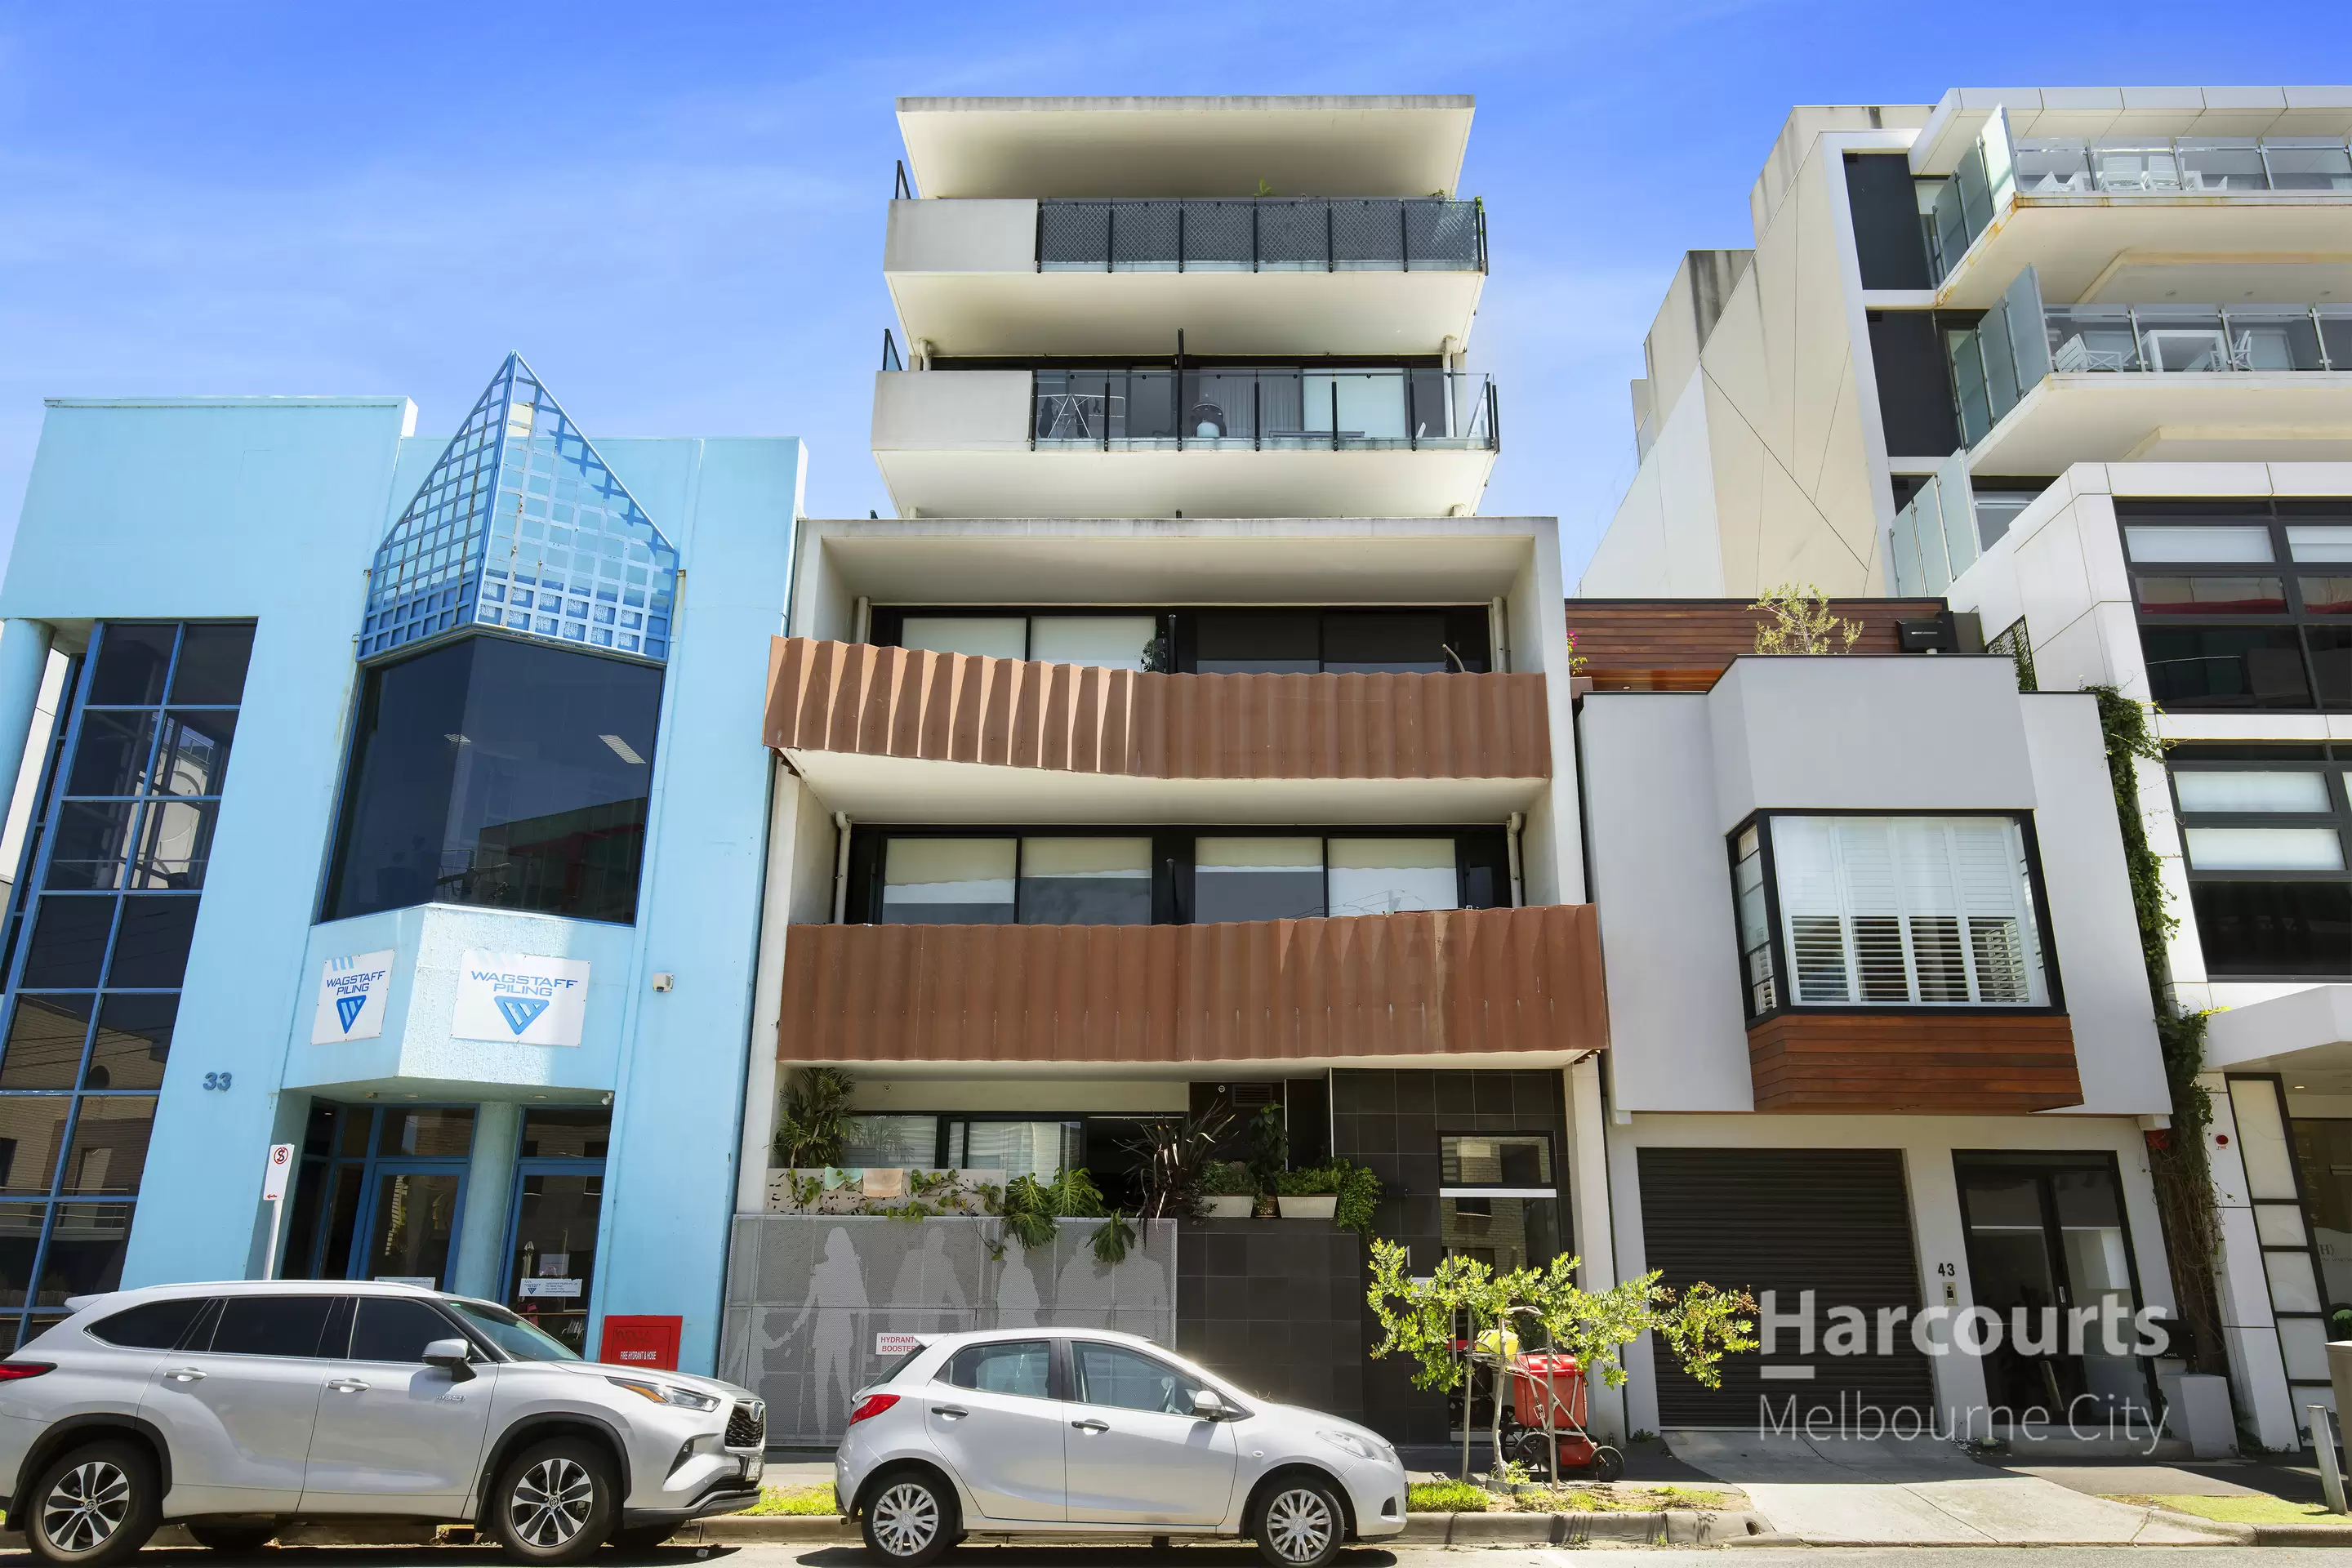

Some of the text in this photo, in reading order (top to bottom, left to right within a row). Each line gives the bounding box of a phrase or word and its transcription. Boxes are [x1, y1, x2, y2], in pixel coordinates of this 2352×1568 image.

[327, 970, 385, 988] WAGSTAFF
[471, 970, 578, 989] WAGSTAFF
[336, 982, 370, 996] PILING
[493, 982, 553, 997] PILING
[203, 1071, 232, 1091] 33
[1938, 1263, 1955, 1276] 43
[620, 1351, 628, 1360] FIRE
[628, 1351, 644, 1360] HYDRANT
[647, 1351, 657, 1360] HOSE
